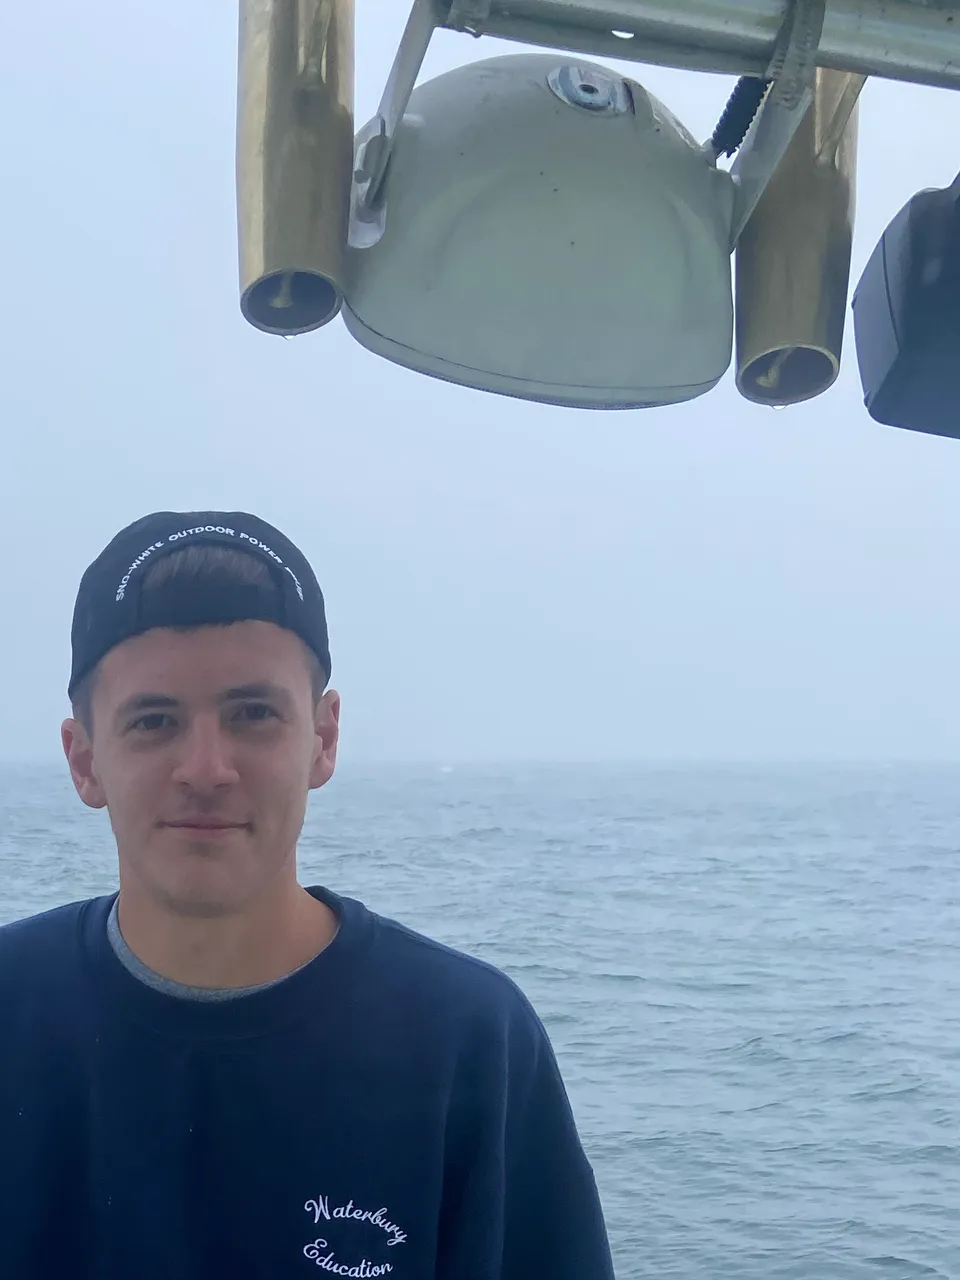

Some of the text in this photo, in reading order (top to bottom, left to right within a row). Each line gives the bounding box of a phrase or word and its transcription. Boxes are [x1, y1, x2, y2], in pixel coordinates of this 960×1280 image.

[115, 525, 283, 602] SNO-WHITE OUTDOOR POWER
[304, 1194, 408, 1246] Waterbury
[303, 1238, 393, 1278] Education
